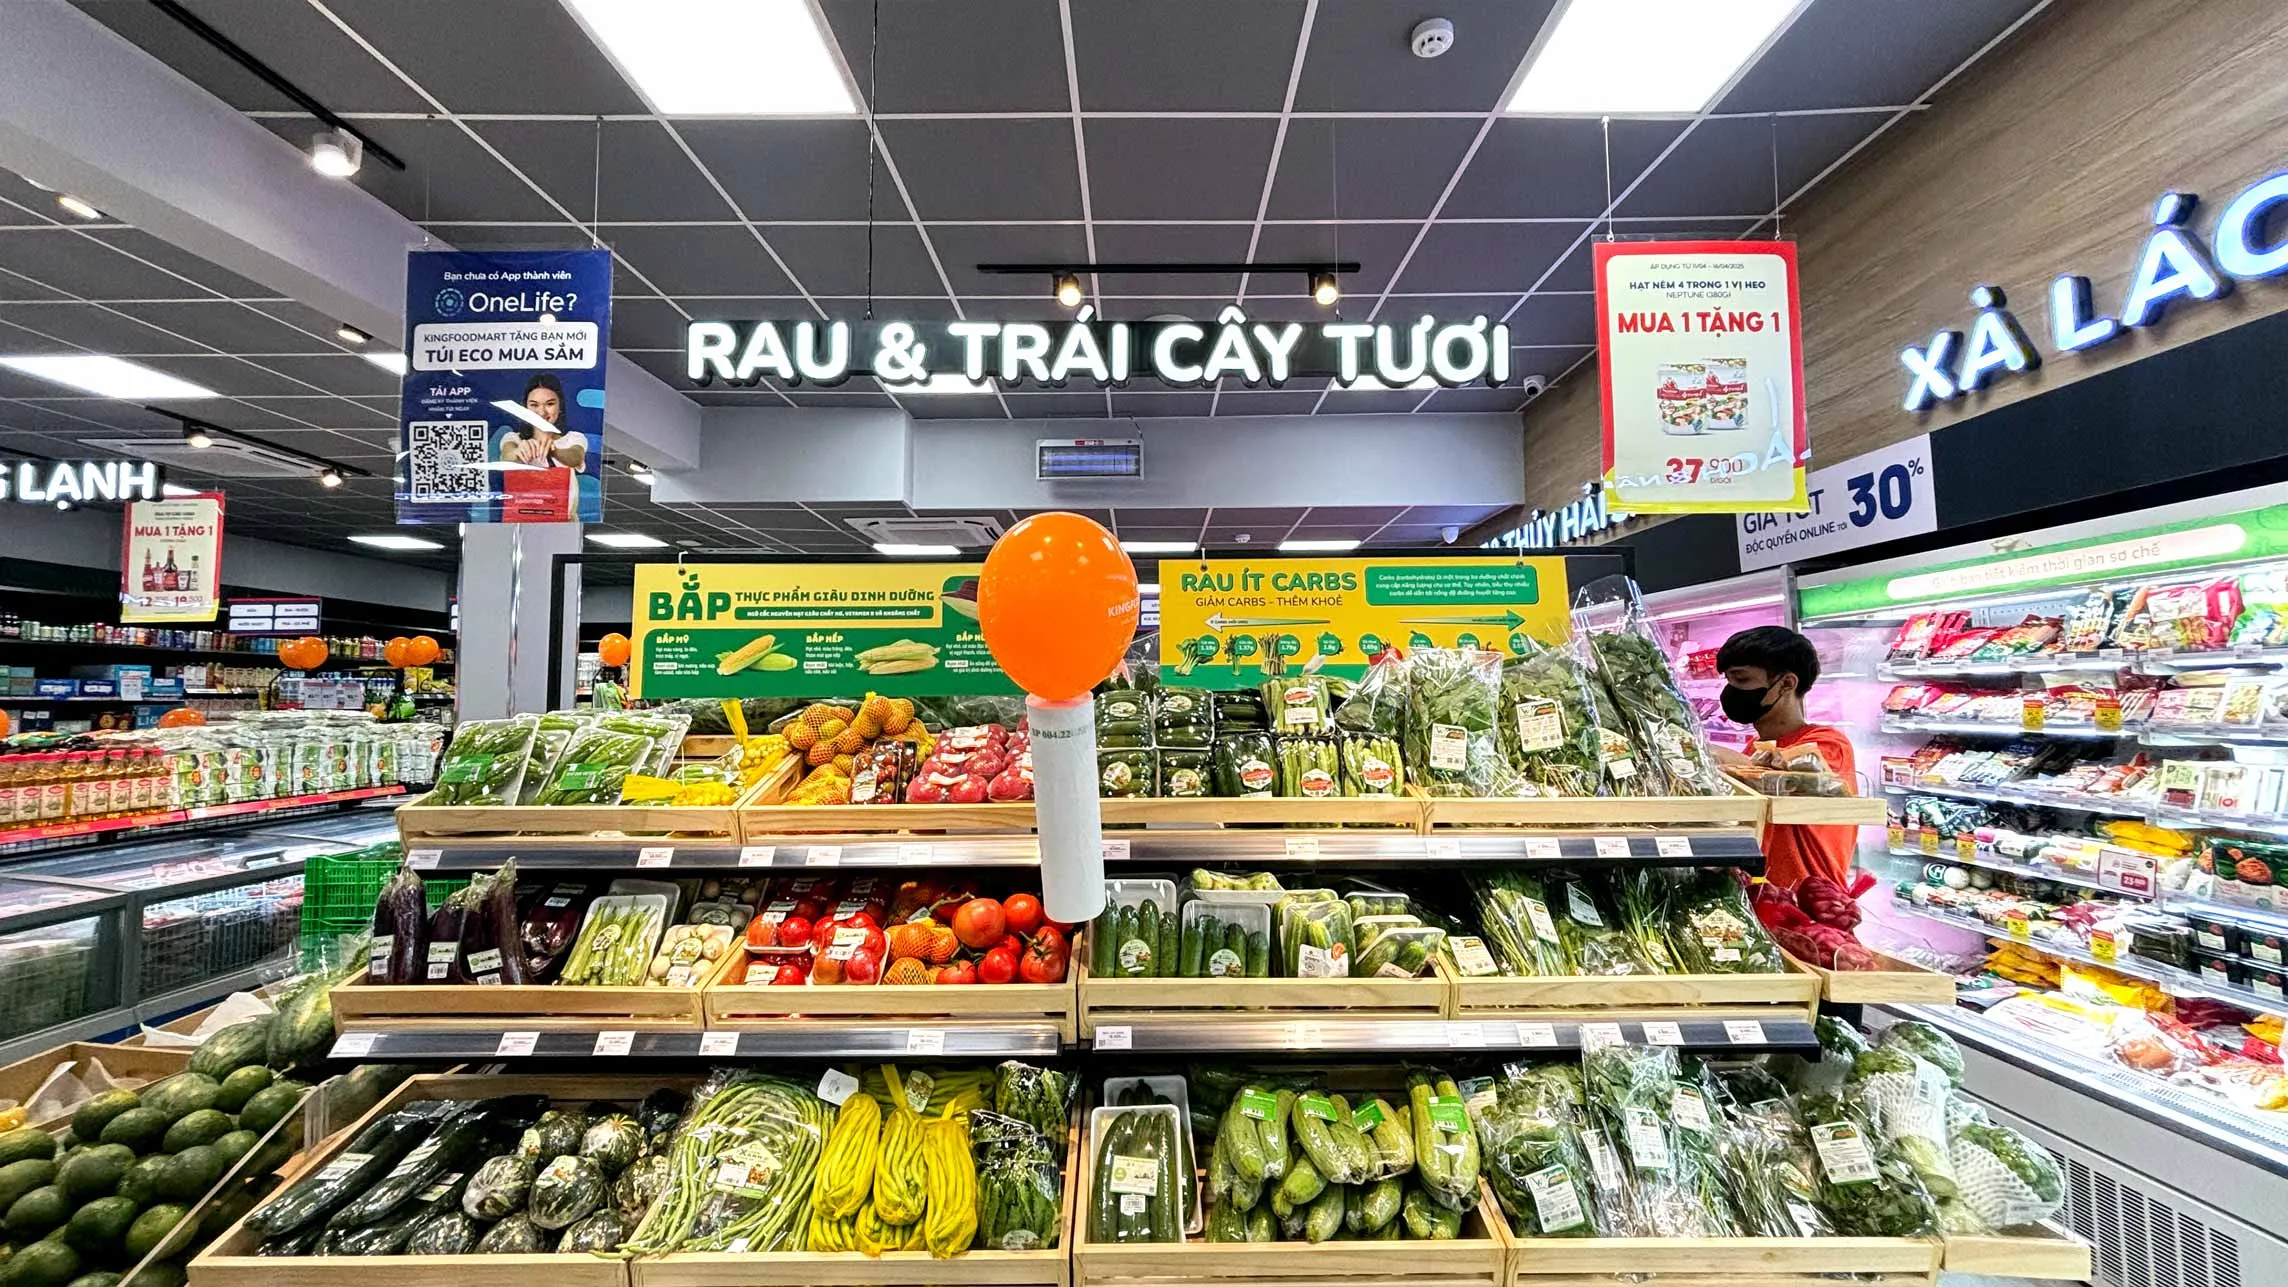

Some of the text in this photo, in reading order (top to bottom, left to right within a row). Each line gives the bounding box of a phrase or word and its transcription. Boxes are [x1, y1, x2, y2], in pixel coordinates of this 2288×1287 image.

[444, 269, 572, 282] Bạn chưa có App thành viên
[1629, 281, 1650, 292] HẠT
[1678, 281, 1684, 289] 4
[1687, 281, 1722, 289] TRONG
[1725, 281, 1729, 289] 1
[1733, 281, 1742, 291] VỊ
[1745, 281, 1766, 289] HEO
[469, 291, 577, 313] OneLife?
[1666, 291, 1704, 299] NEPTUNE
[1618, 306, 1780, 338] MUA 1 TẶNG 1
[424, 329, 587, 344] KINGFOODMART TẶNG BẠN MỚI
[687, 304, 1510, 383] RAU & TRÁI CÂY TƯƠI
[425, 342, 584, 363] TÚI ECO MUA SẮM
[429, 384, 472, 396] TẢI APP
[1665, 457, 1704, 484] 37
[19, 462, 156, 511] LẠNH
[1847, 457, 1924, 528] 30%
[1562, 482, 1607, 543] HẢI
[134, 523, 213, 539] MUA 1 TẶNG 1
[1745, 539, 1765, 555] ĐỘC
[1766, 530, 1797, 551] QUYỀN
[1799, 521, 1835, 541] ONLINE
[2074, 551, 2105, 571] gian
[2132, 541, 2161, 560] chế
[1182, 567, 1357, 592] RAU ÍT CARBS
[649, 573, 732, 621] BẮP
[735, 585, 935, 605] THỰC PHẨM GIÀU DINH DƯỠNG
[1195, 594, 1225, 608] GIẢM
[1228, 597, 1266, 607] CARBS
[1277, 595, 1309, 607] THÊM
